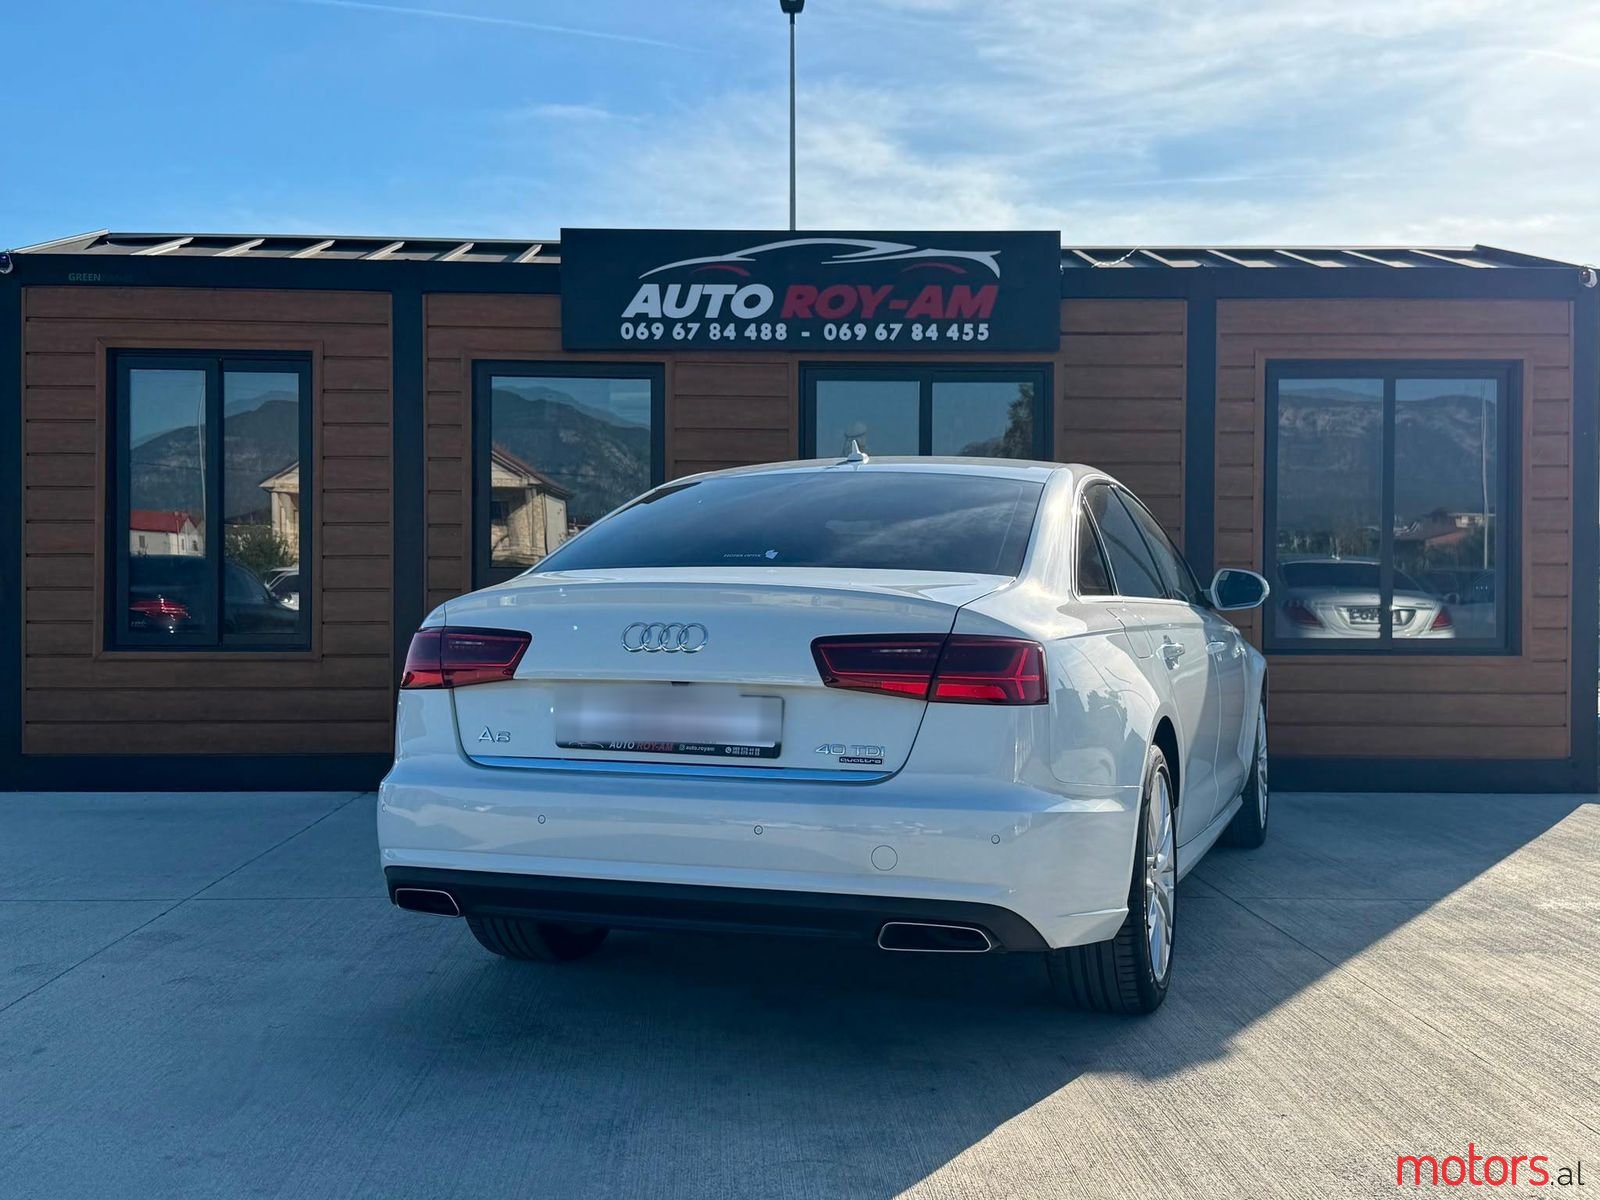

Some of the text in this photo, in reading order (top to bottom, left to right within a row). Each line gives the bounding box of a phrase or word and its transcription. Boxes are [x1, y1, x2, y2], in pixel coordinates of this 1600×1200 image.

[621, 284, 998, 319] AUTO ROY-AM
[620, 323, 664, 340] 069
[672, 323, 700, 340] 67
[709, 323, 736, 340] 84
[744, 323, 787, 340] 488
[823, 323, 867, 340] 069
[875, 323, 902, 340] 67
[911, 323, 938, 341] 84
[946, 323, 989, 341] 455
[479, 726, 511, 743] A6
[609, 740, 635, 749] AUTO
[815, 744, 885, 757] 40 TDI
